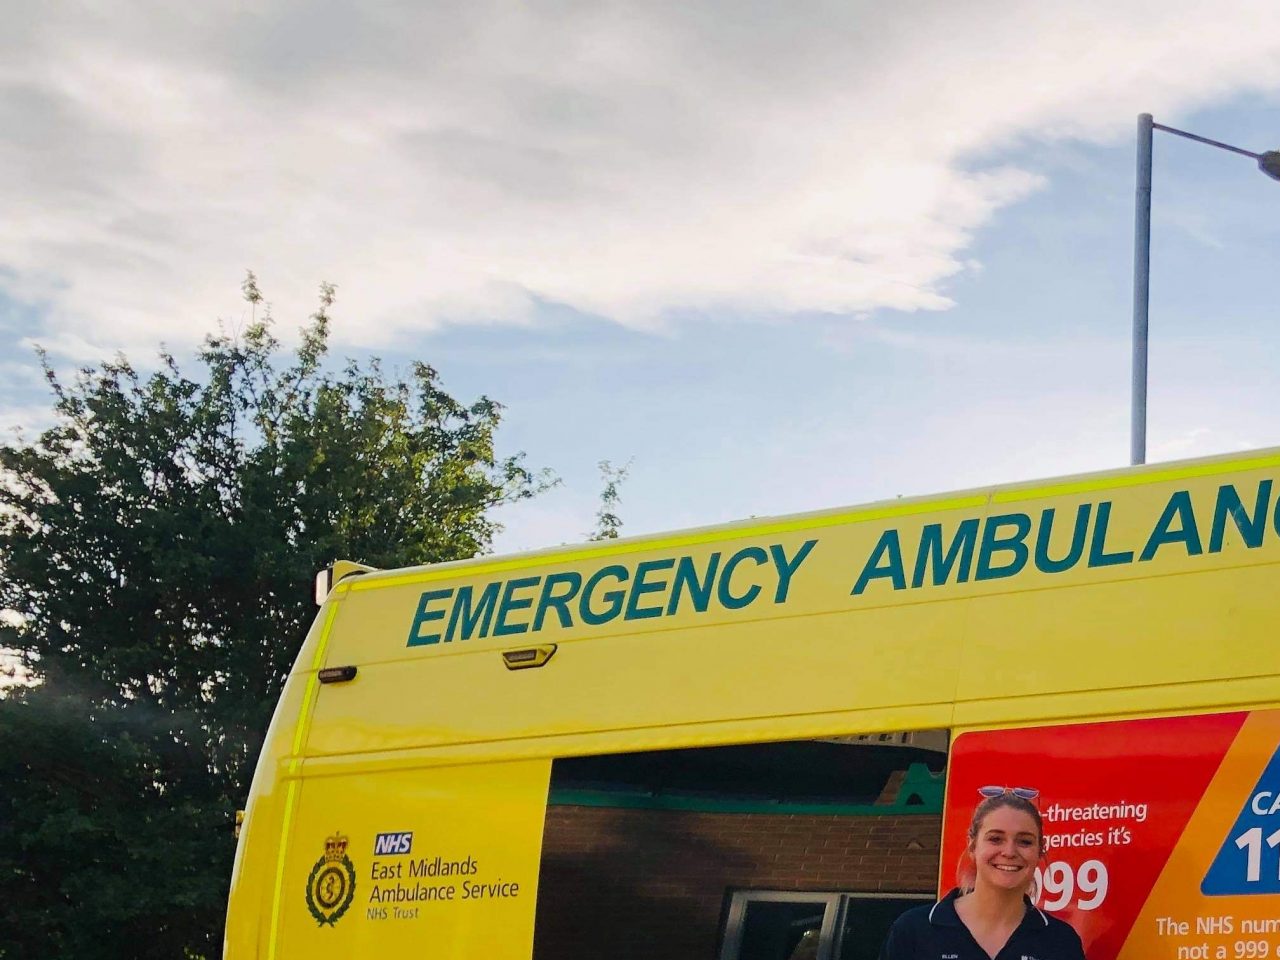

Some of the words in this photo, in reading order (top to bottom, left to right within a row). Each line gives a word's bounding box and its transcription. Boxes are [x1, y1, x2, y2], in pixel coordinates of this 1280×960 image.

[406, 539, 819, 648] EMERGENCY
[375, 833, 412, 854] NHS
[1107, 826, 1132, 845] it's
[371, 861, 403, 880] East
[409, 856, 478, 878] Midlands
[369, 883, 456, 903] Ambulance
[462, 878, 519, 899] Service
[367, 907, 388, 920] NHS
[393, 907, 419, 919] Trust
[1155, 917, 1190, 936] The
[1196, 915, 1234, 935] NHS
[1177, 942, 1209, 960] not
[1215, 945, 1227, 960] a
[1233, 940, 1269, 959] 999
